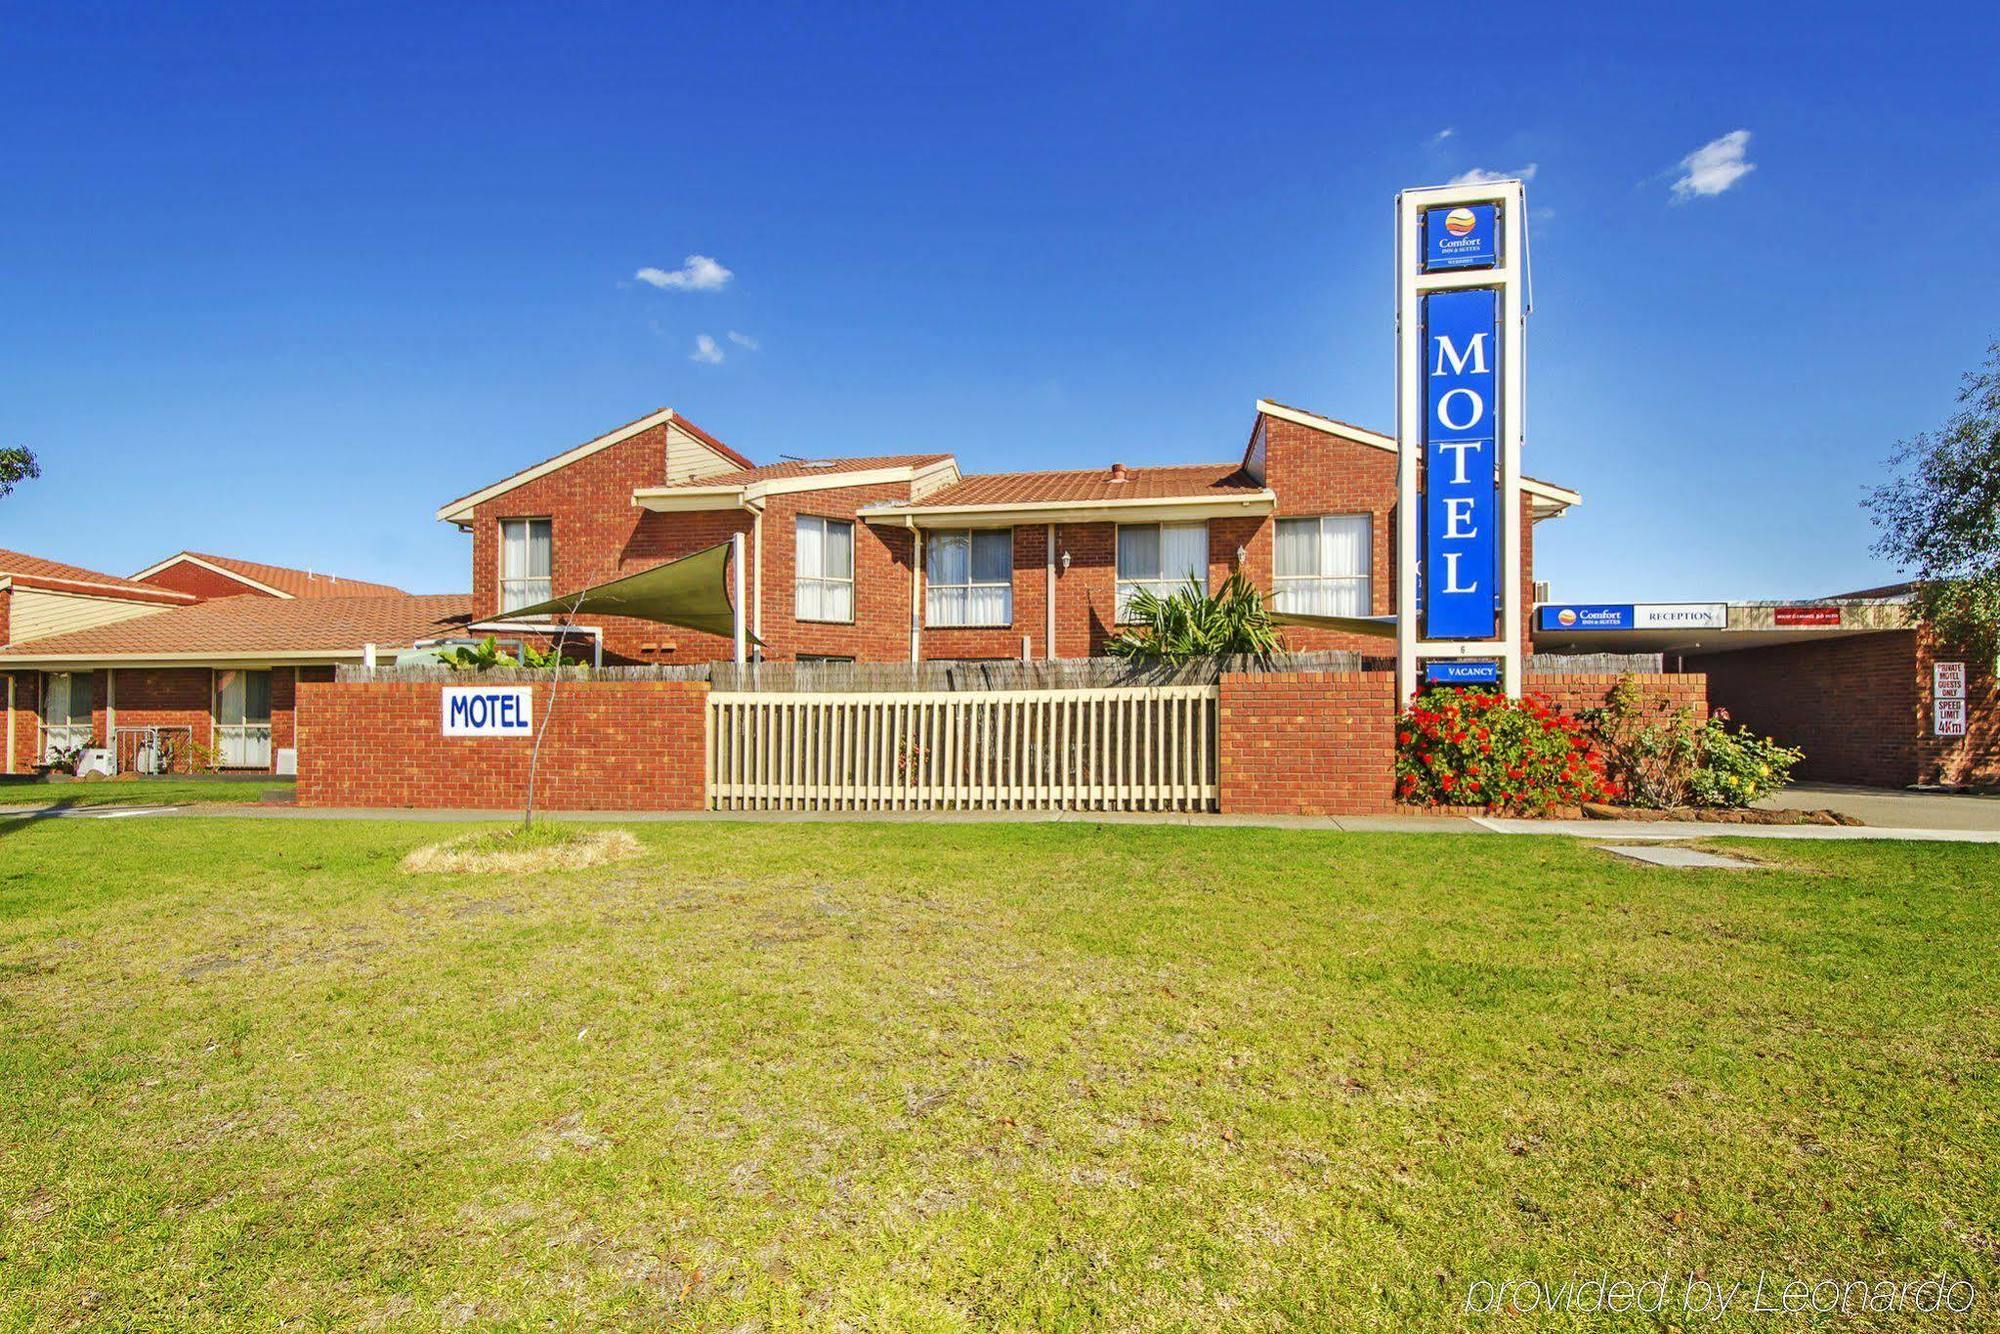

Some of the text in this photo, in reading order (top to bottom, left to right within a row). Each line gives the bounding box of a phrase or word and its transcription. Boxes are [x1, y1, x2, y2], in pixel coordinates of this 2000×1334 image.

[1439, 237, 1481, 248] Comfort
[1431, 332, 1490, 594] MOTEL
[1579, 609, 1622, 620] Comfort
[1649, 611, 1712, 621] RECEPTION
[1448, 667, 1494, 676] VACANCY
[1938, 664, 1961, 672] PRIVATE
[1939, 672, 1959, 680] MOTEL
[1938, 681, 1961, 689] GUESTS
[1941, 689, 1958, 697] ONLY
[1938, 701, 1961, 710] SPEED
[451, 695, 528, 728] MOTEL
[1940, 710, 1959, 719] LIMIT
[1938, 721, 1962, 734] 4Km
